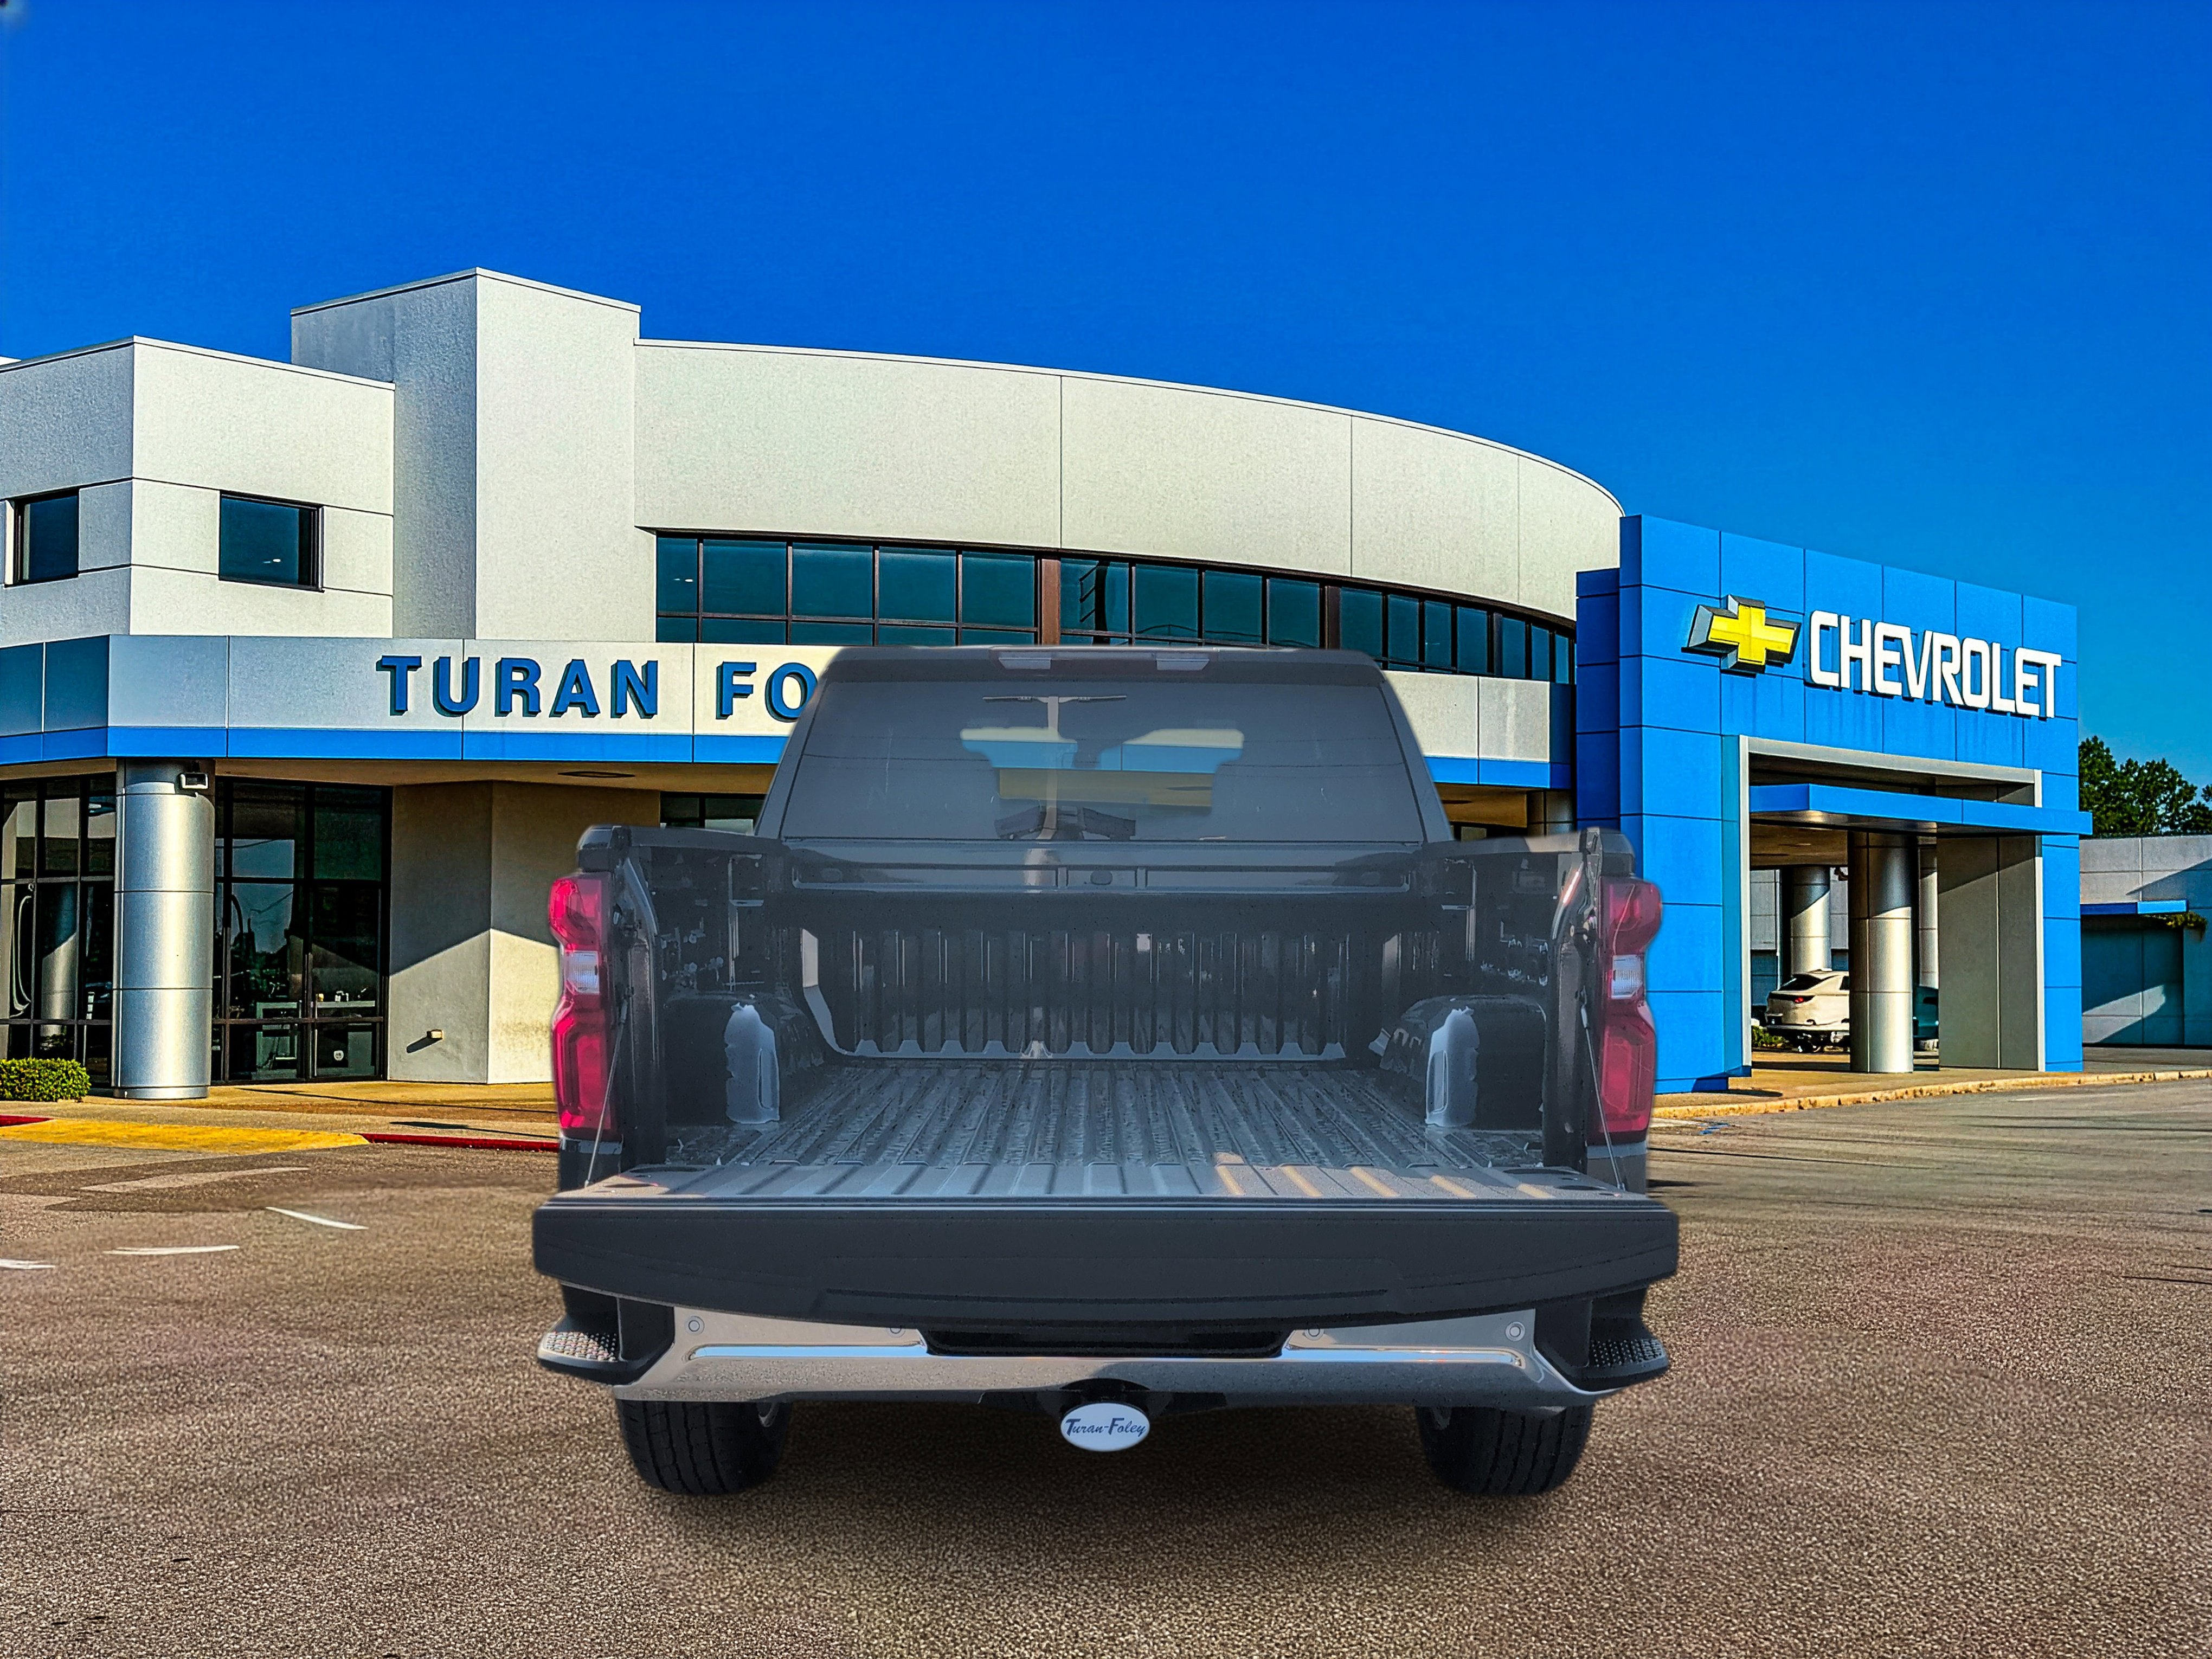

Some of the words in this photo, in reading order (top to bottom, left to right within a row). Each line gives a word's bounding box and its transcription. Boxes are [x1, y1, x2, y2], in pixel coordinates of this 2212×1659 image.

[377, 655, 658, 719] TURAN
[1810, 610, 2062, 718] CHEVROLET
[1065, 1417, 1146, 1437] Turan-Foley
